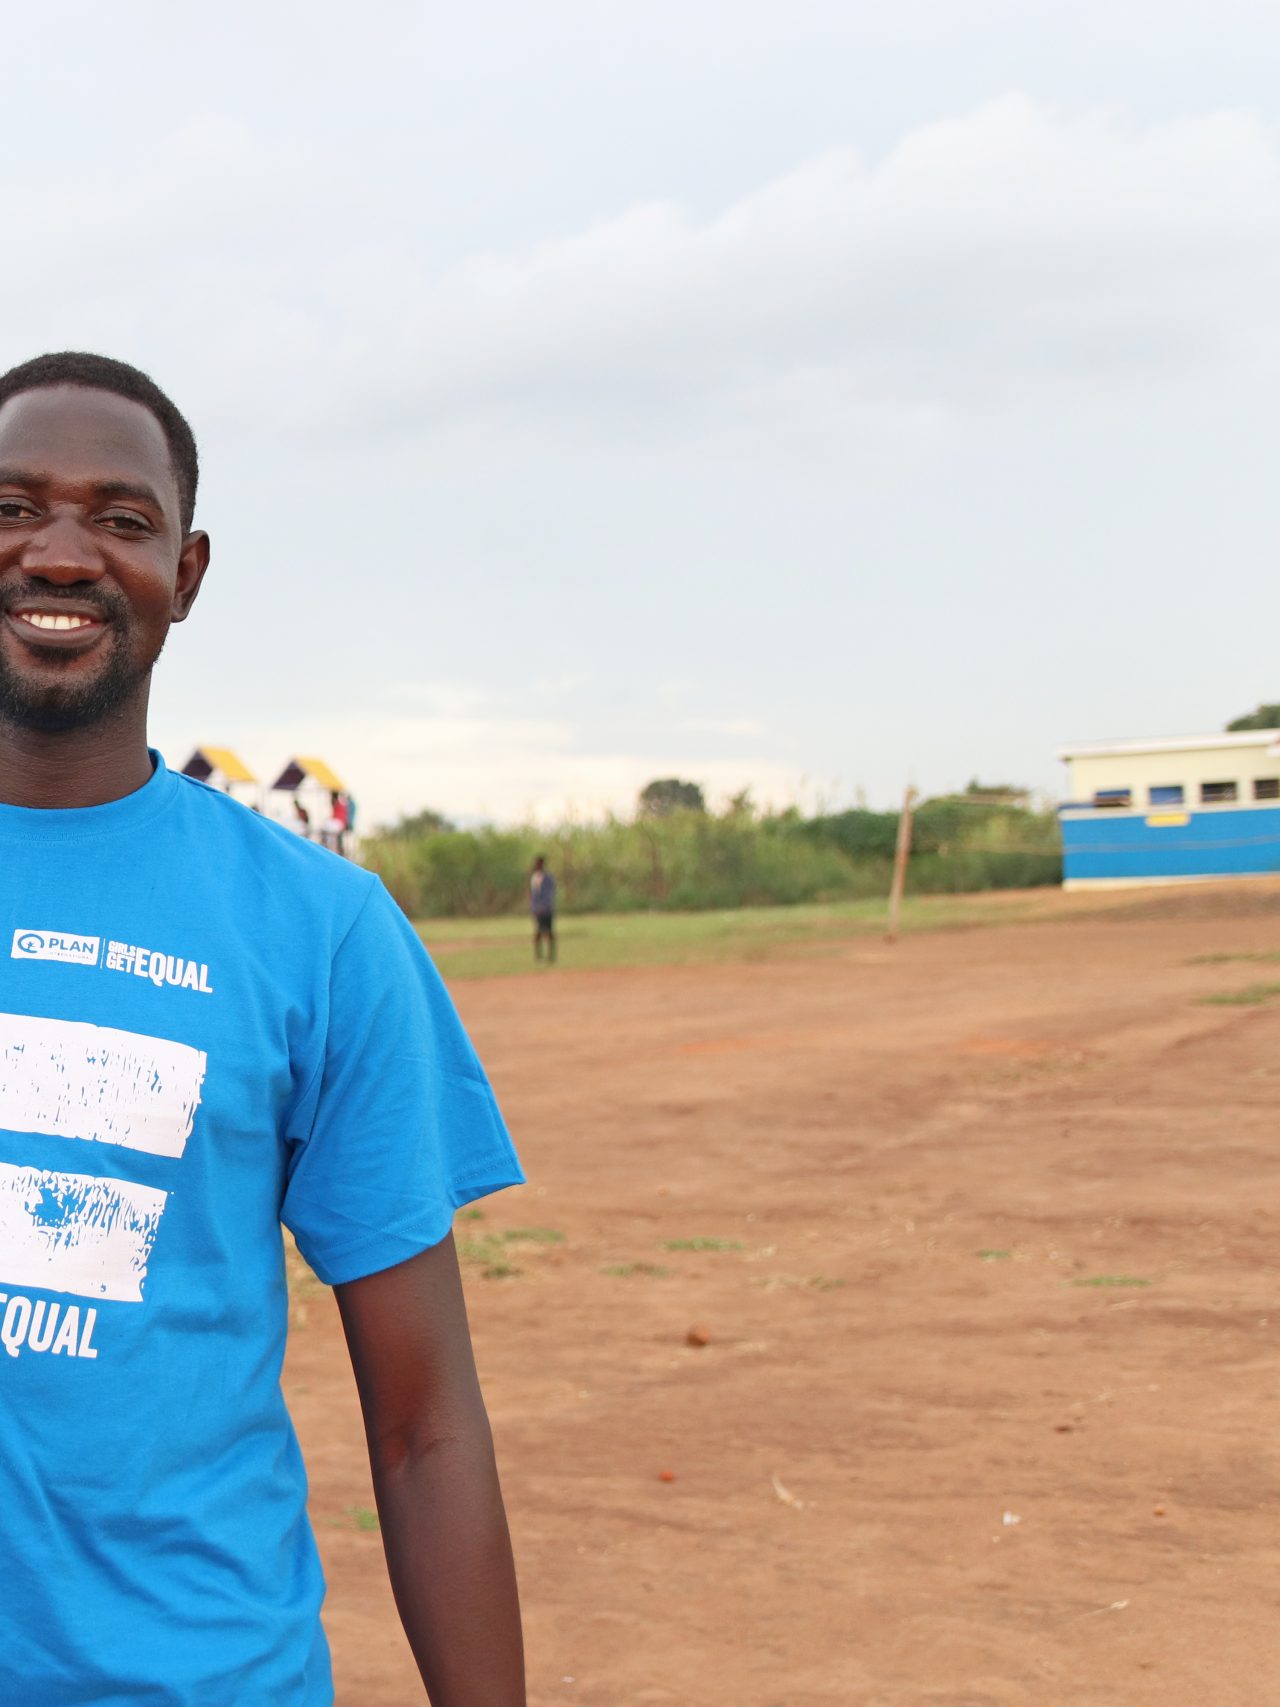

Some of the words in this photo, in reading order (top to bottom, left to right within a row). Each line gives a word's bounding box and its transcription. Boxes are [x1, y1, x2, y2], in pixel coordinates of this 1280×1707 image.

[48, 937, 95, 954] PLAN
[108, 940, 137, 957] GIRLS
[106, 951, 136, 974] GET
[133, 947, 213, 993] EQUAL
